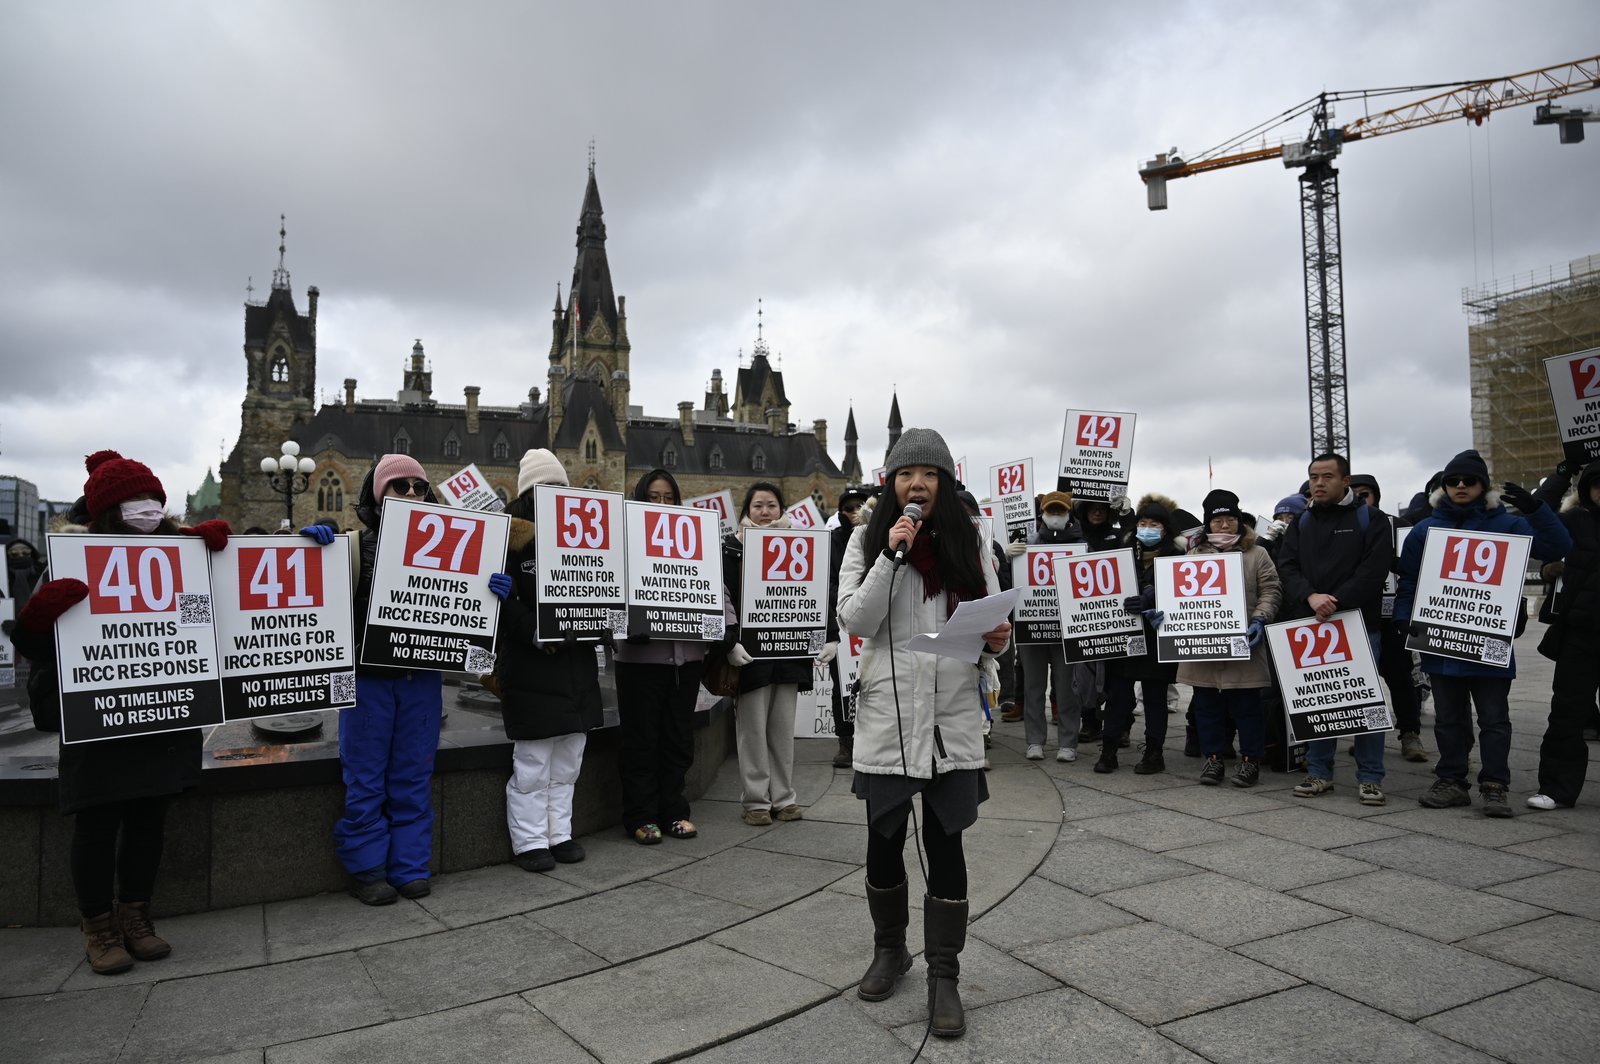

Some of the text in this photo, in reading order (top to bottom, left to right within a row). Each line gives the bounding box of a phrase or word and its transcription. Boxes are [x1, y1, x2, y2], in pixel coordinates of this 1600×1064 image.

[1580, 358, 1600, 397] 2
[1081, 417, 1115, 447] 42
[1568, 425, 1596, 437] IRCC
[1584, 441, 1598, 450] NO
[1079, 450, 1112, 458] MONTHS
[1070, 458, 1102, 467] WAITING
[1001, 466, 1022, 494] 32
[1064, 467, 1124, 478] IRCC RESPONSE
[452, 473, 474, 497] 19
[1081, 481, 1110, 489] TIMELINE
[563, 498, 604, 548] 53
[412, 514, 476, 572] 27
[652, 513, 697, 558] 40
[562, 555, 603, 567] MONTHS
[767, 537, 808, 580] 28
[1448, 540, 1497, 582] 19
[250, 548, 313, 607] 41
[551, 570, 614, 582] WAITING FOR
[653, 563, 698, 576] MONTHS
[99, 547, 174, 611] 40
[408, 575, 468, 593] MONTHS
[642, 576, 710, 590] WAITING FOR
[1075, 560, 1115, 597] 90
[1179, 561, 1221, 596] 32
[545, 585, 620, 597] IRCC RESPONSE
[635, 590, 717, 604] IRCC RESPONSE
[766, 587, 807, 596] MONTHS
[1033, 589, 1056, 597] MONT
[1442, 585, 1491, 600] MONTHS
[390, 590, 481, 612] WAITING FOR
[755, 599, 816, 609] WAITING FOR
[1080, 599, 1118, 610] MONTHS
[1179, 601, 1221, 609] MONTHS
[1429, 596, 1502, 616] WAITING FOR
[378, 606, 488, 629] IRCC RESPONSE
[556, 608, 567, 618] NO
[647, 611, 705, 621] NO TIMELINE
[748, 612, 821, 622] IRCC RESPONSE
[1071, 611, 1109, 623] WAITING
[1169, 610, 1233, 620] WAITING FOR
[1419, 608, 1507, 630] IRCC RESPONSE
[251, 613, 318, 630] MONTHS
[560, 621, 607, 630] NO RESULTS
[651, 622, 663, 631] NO
[1067, 619, 1137, 635] IRCC RESPONSE
[1164, 621, 1240, 632] IRCC RESPONSE
[102, 622, 178, 640] MONTHS
[758, 631, 811, 640] NO TIMELINES
[1427, 627, 1485, 644] NO TIMELINE
[234, 630, 335, 650] WAITING FOR
[390, 632, 470, 650] NO TIMELINES
[761, 642, 808, 651] NO RESULTS
[1174, 637, 1230, 647] NO TIMELINES
[1295, 623, 1346, 667] 22
[1429, 638, 1484, 655] NO RESULTS
[82, 640, 198, 661] WAITING FOR
[393, 647, 463, 663] NO RESULTS
[1095, 644, 1127, 654] RESULTS
[1178, 646, 1228, 655] NO RESULTS
[224, 647, 344, 670] IRCC RESPONSE
[72, 658, 209, 683] IRCC RESPONSE
[1303, 667, 1350, 683] MONTHS
[242, 674, 330, 693] NO TIMELINES
[1295, 677, 1366, 696] WAITING FOR
[95, 688, 194, 710] NO TIMELINES
[248, 689, 325, 708] NO RESULTS
[815, 688, 833, 696] vie
[1292, 688, 1376, 709] IRCC RESPONSE
[102, 705, 190, 727] NO RESULTS
[1307, 709, 1363, 723] NO TIMELINE
[1314, 719, 1367, 732] NO RESULTS
